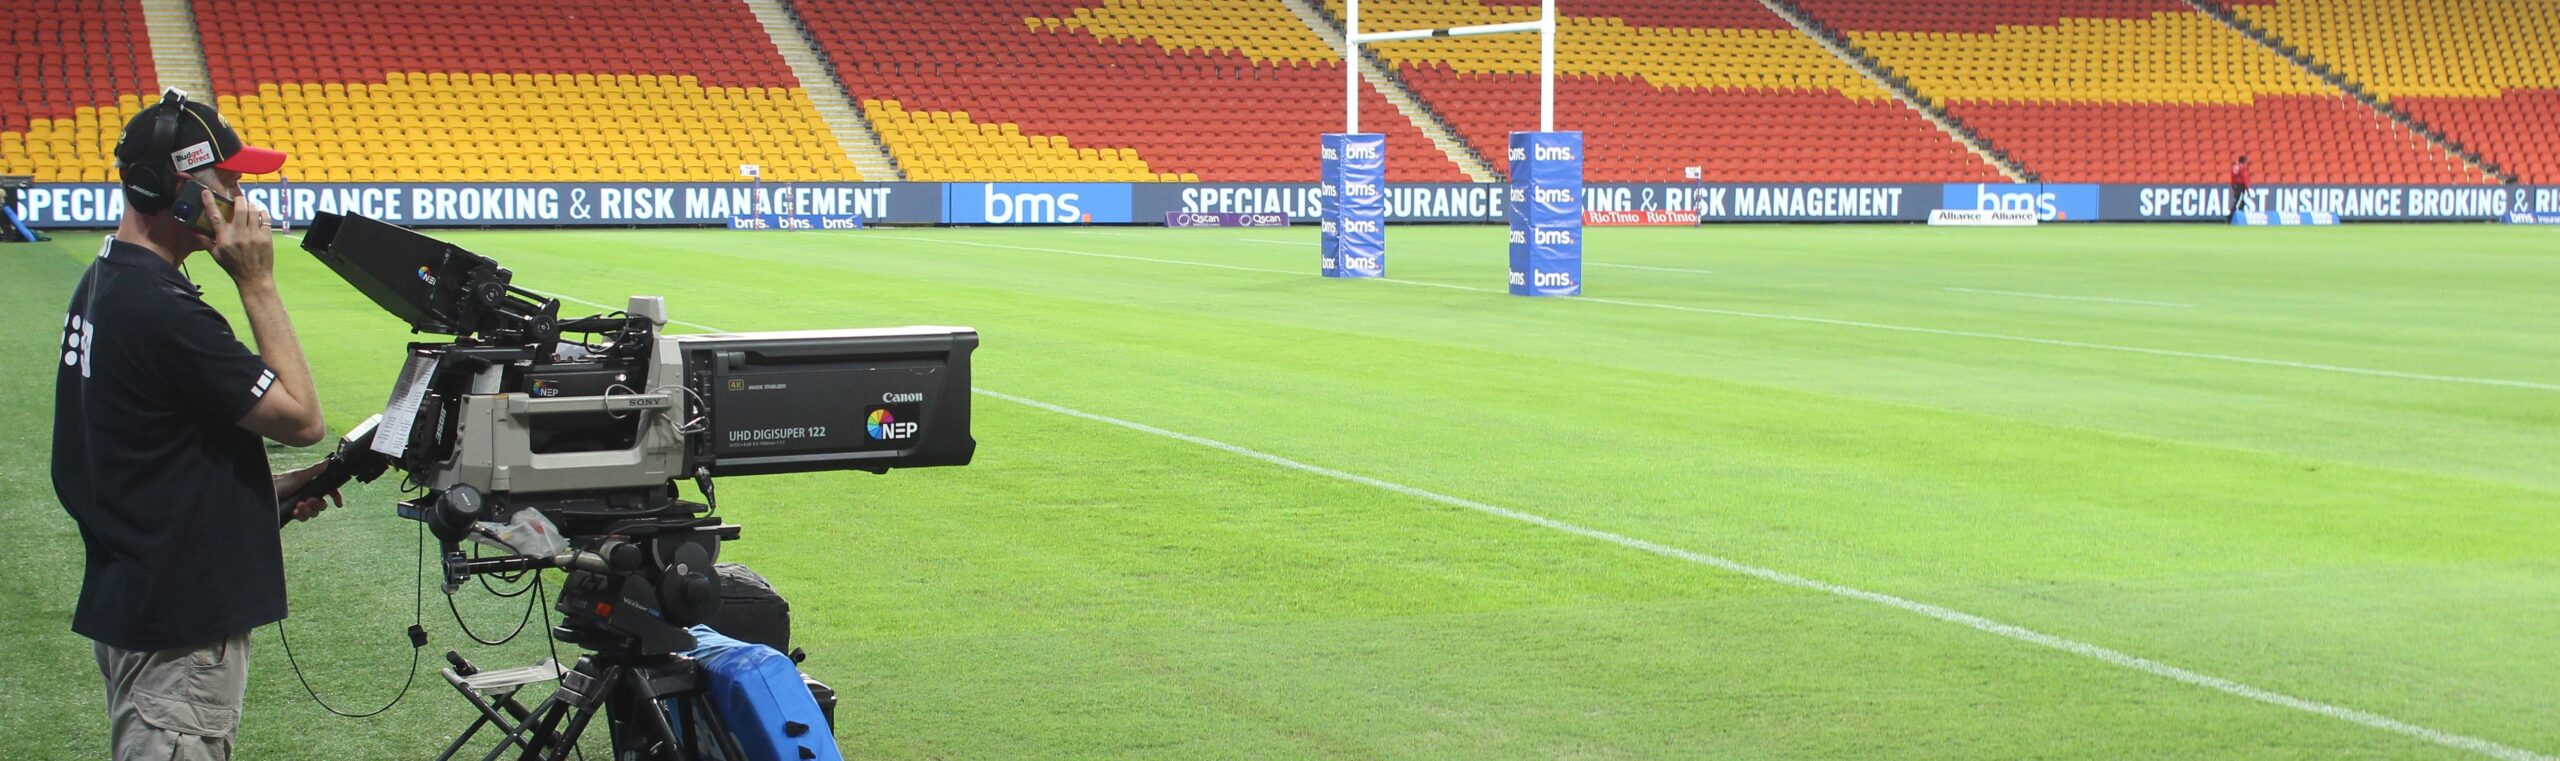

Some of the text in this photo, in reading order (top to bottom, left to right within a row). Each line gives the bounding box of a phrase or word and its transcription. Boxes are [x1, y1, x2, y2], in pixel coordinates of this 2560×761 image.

[176, 148, 203, 162] Budget
[188, 153, 210, 165] Direct
[17, 188, 124, 221] SPECIA
[243, 188, 402, 221] SURANCE
[413, 188, 558, 220] BROKING
[570, 188, 591, 219] &
[600, 188, 675, 220] RISK
[685, 187, 890, 219] MANAGEMENT
[1182, 187, 1502, 218] SPECIALIS SURANCE
[1641, 187, 1657, 211] &
[1666, 187, 1727, 216] RISK
[1735, 187, 1902, 216] MANAGEMENT
[2140, 187, 2560, 217] SPECIALST INSURANCE BROKING & RI
[1191, 213, 1220, 224] Qscan
[1252, 213, 1281, 224] Qscan
[1939, 211, 1981, 221] Alliance
[1991, 211, 2033, 221] Alliance
[540, 388, 559, 397] NEP
[882, 392, 923, 403] Canon
[629, 398, 660, 407] SONY
[729, 426, 826, 442] UHD DIGISUPER 122
[882, 421, 918, 440] NEP
